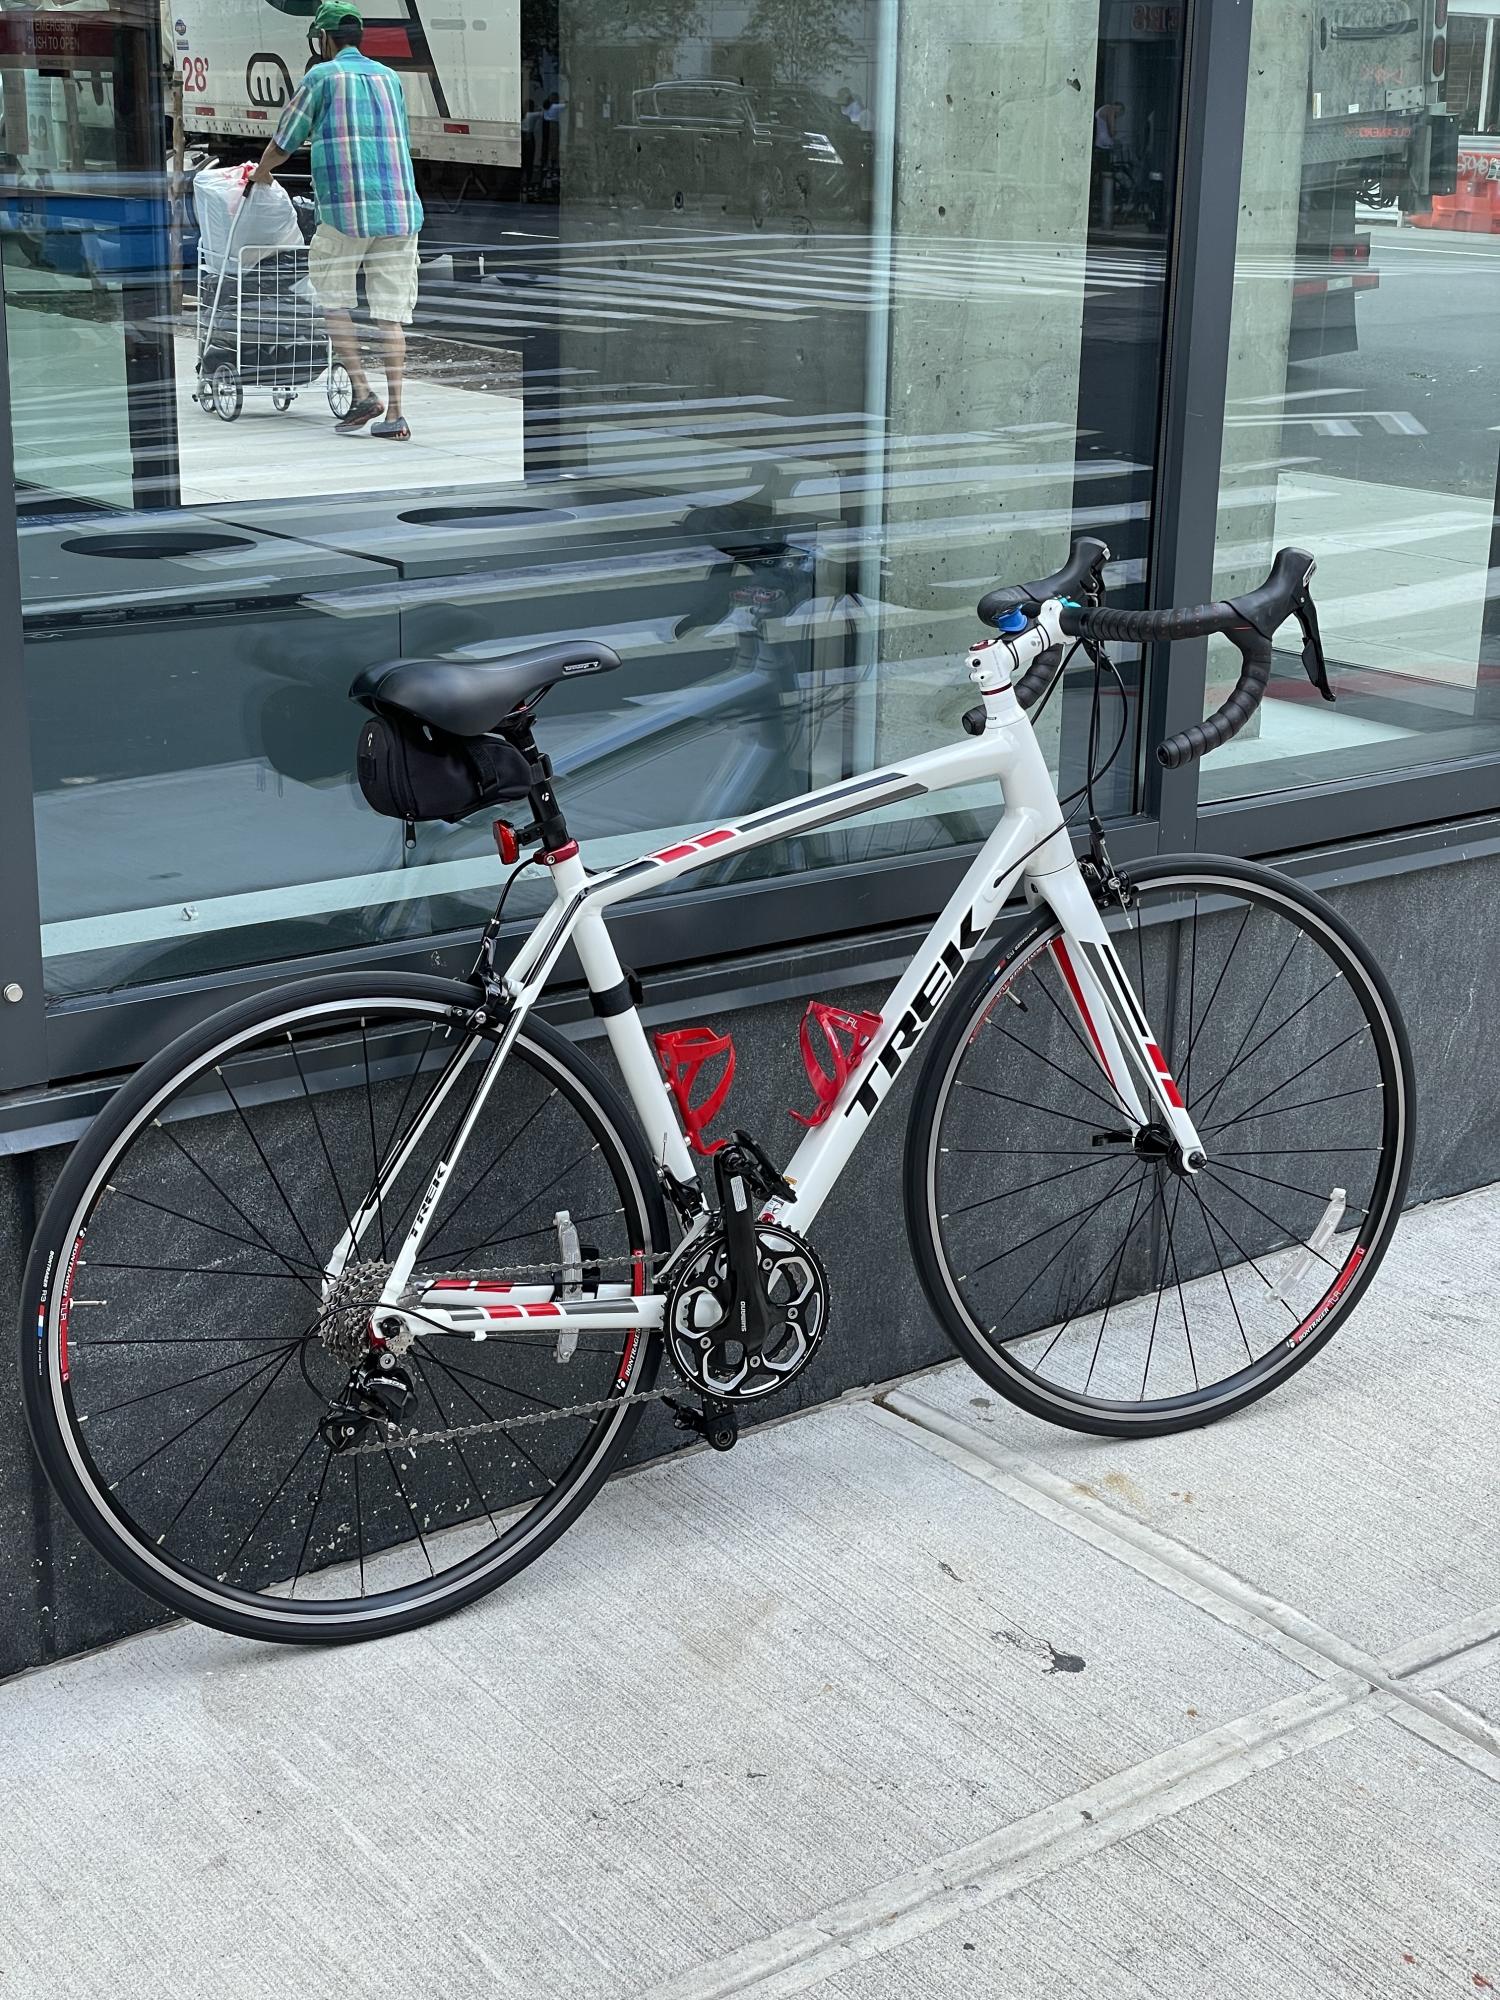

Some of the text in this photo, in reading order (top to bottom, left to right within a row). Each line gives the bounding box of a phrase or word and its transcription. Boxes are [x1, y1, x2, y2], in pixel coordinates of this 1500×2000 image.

[27, 36, 80, 50] PUSH TO OPEN
[35, 18, 80, 32] EMERGENCY
[844, 904, 987, 1118] TREK
[407, 1164, 447, 1241] TREK
[40, 1250, 55, 1302] BONTRAGER R3
[60, 1242, 79, 1321] BONTRAGER TLR
[1298, 1290, 1341, 1342] BONTRAGER TLR
